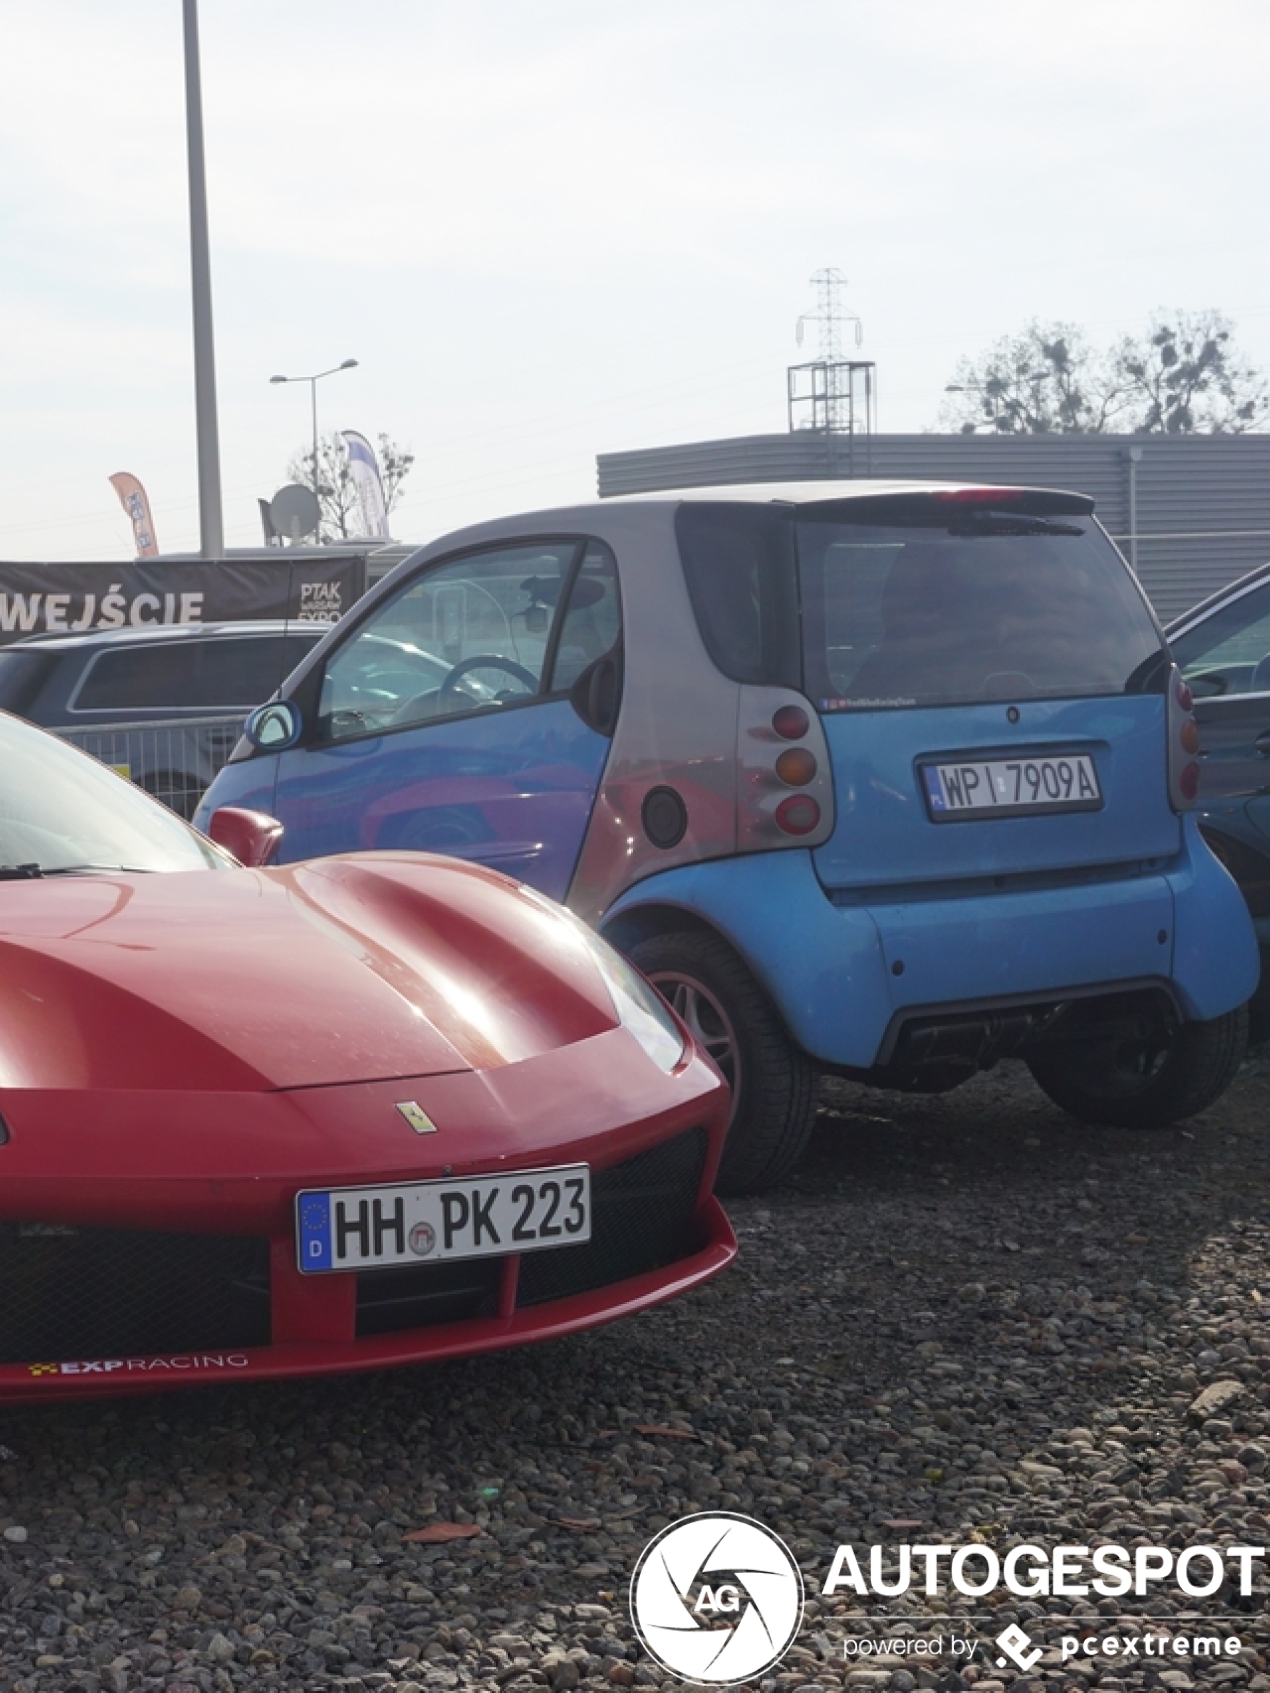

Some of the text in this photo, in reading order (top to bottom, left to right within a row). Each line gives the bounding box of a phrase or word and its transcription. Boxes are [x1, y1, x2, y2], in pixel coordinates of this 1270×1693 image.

[301, 582, 342, 600] PTAK
[1005, 759, 1096, 803] 7909A
[335, 1178, 585, 1259] HH PK 223
[309, 1240, 322, 1257] D
